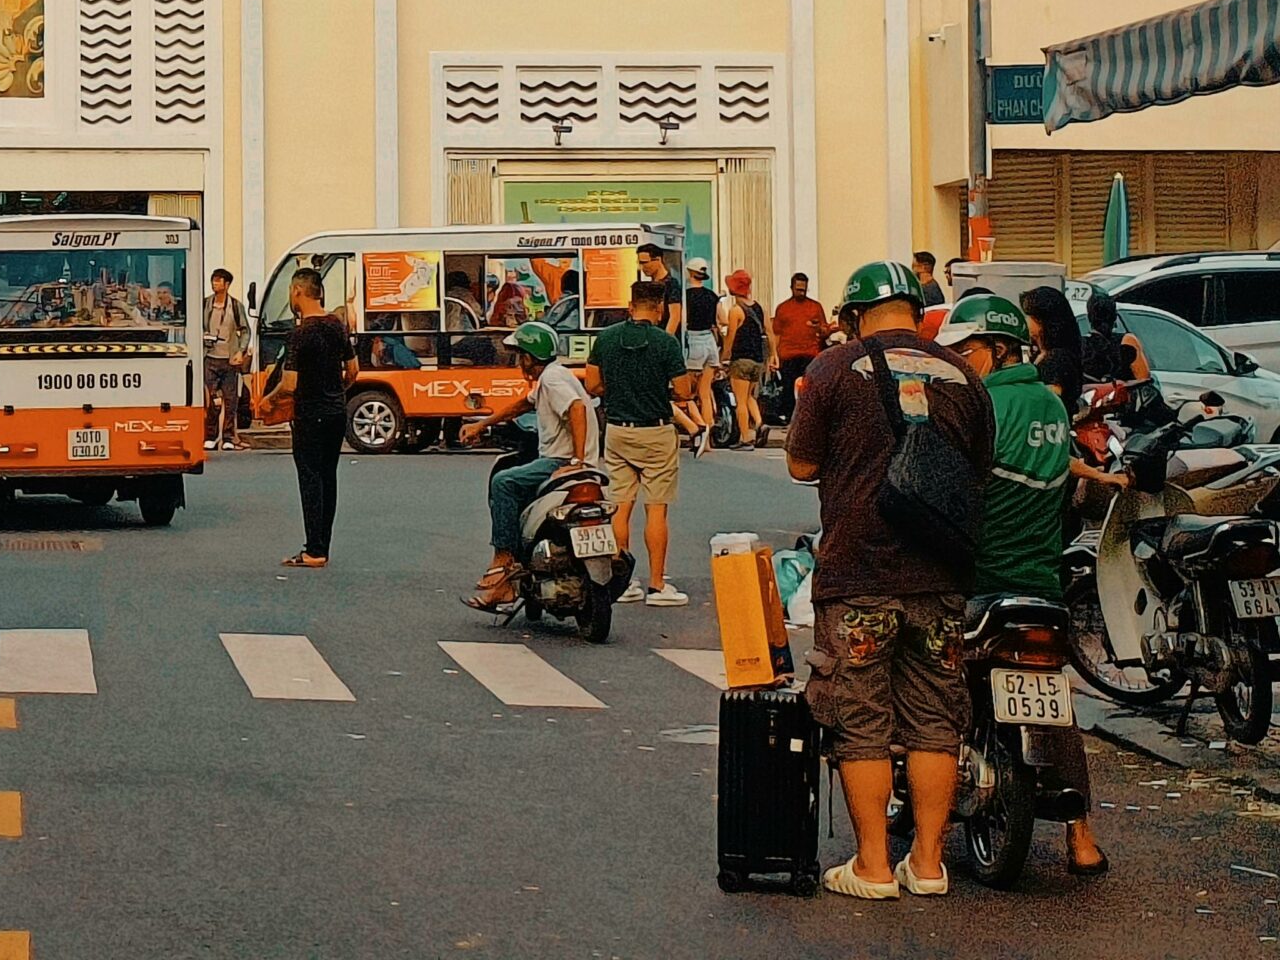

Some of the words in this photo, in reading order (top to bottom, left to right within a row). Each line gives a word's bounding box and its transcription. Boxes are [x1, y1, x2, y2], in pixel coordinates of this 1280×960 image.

[997, 98, 1028, 118] PHAN
[52, 232, 101, 248] Saigon
[101, 232, 121, 246] PT
[986, 311, 1019, 326] Grab
[38, 374, 72, 390] 1900
[122, 373, 141, 389] 69
[413, 379, 471, 397] MEX
[1007, 697, 1059, 719] 0539
